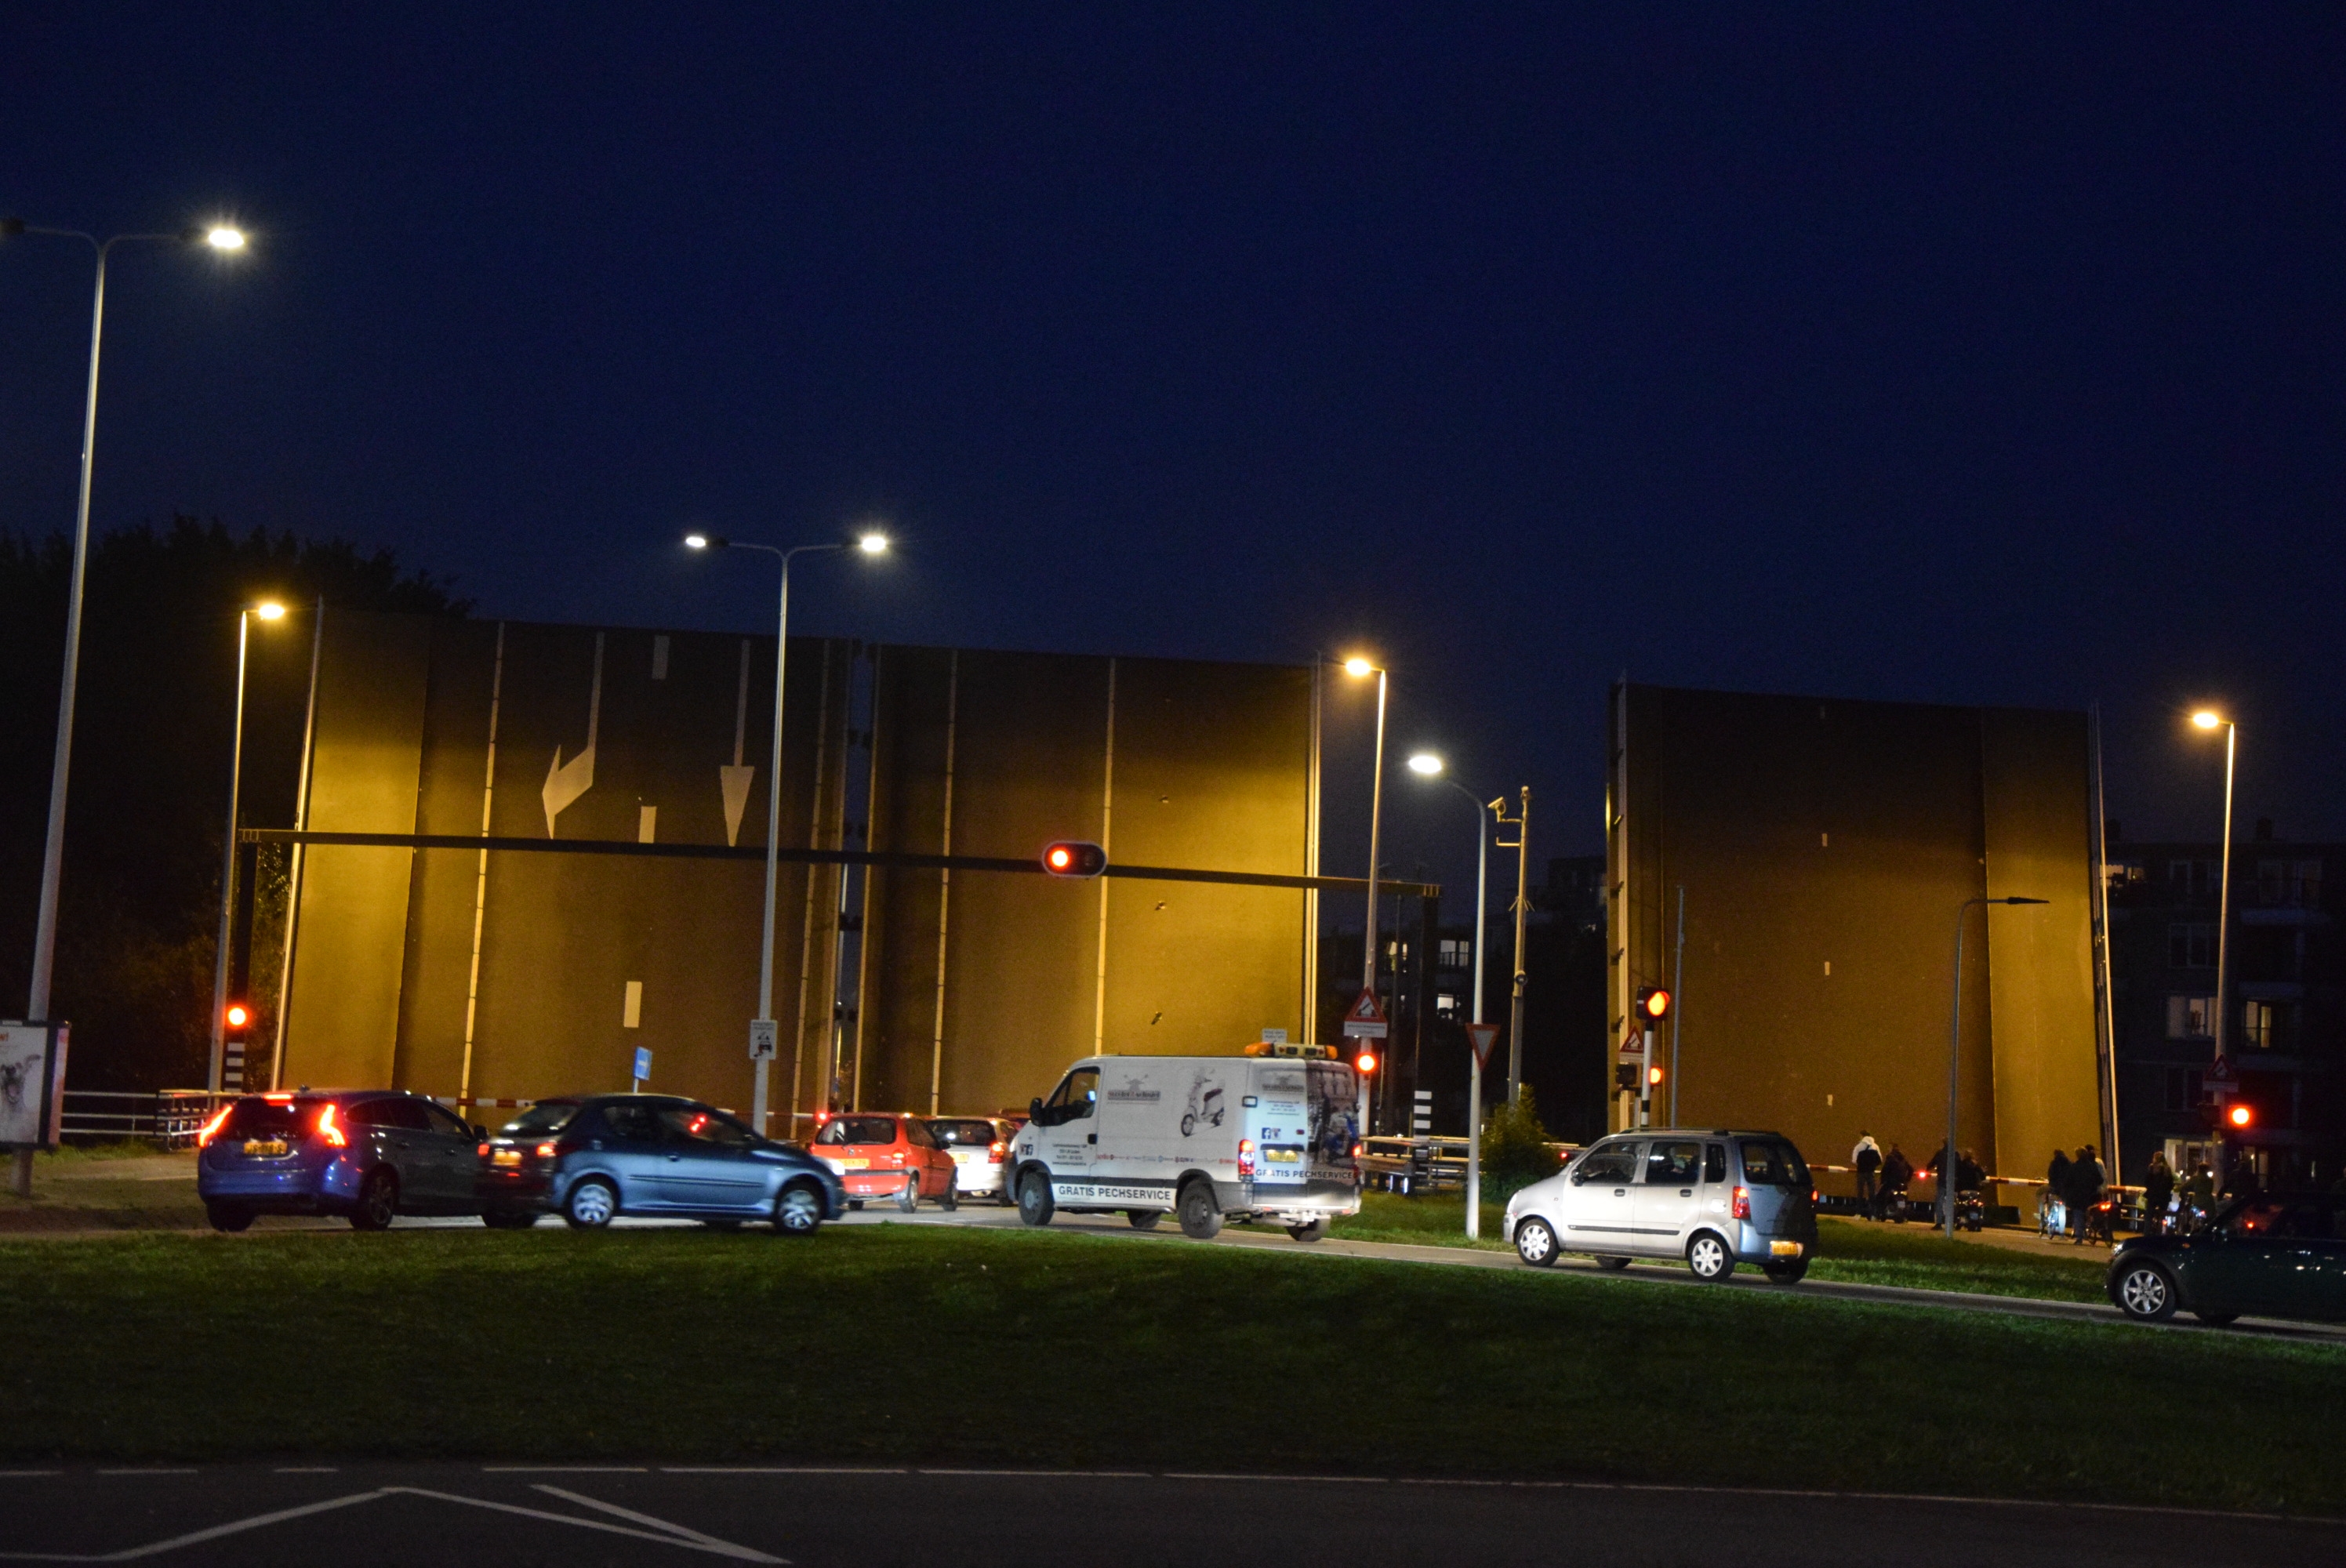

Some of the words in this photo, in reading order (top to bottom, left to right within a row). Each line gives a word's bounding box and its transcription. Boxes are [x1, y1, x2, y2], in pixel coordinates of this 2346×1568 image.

[1293, 1171, 1353, 1179] PECHSERVICE
[1059, 1185, 1095, 1196] GRATIS
[1099, 1188, 1171, 1200] PECHSERVICE
